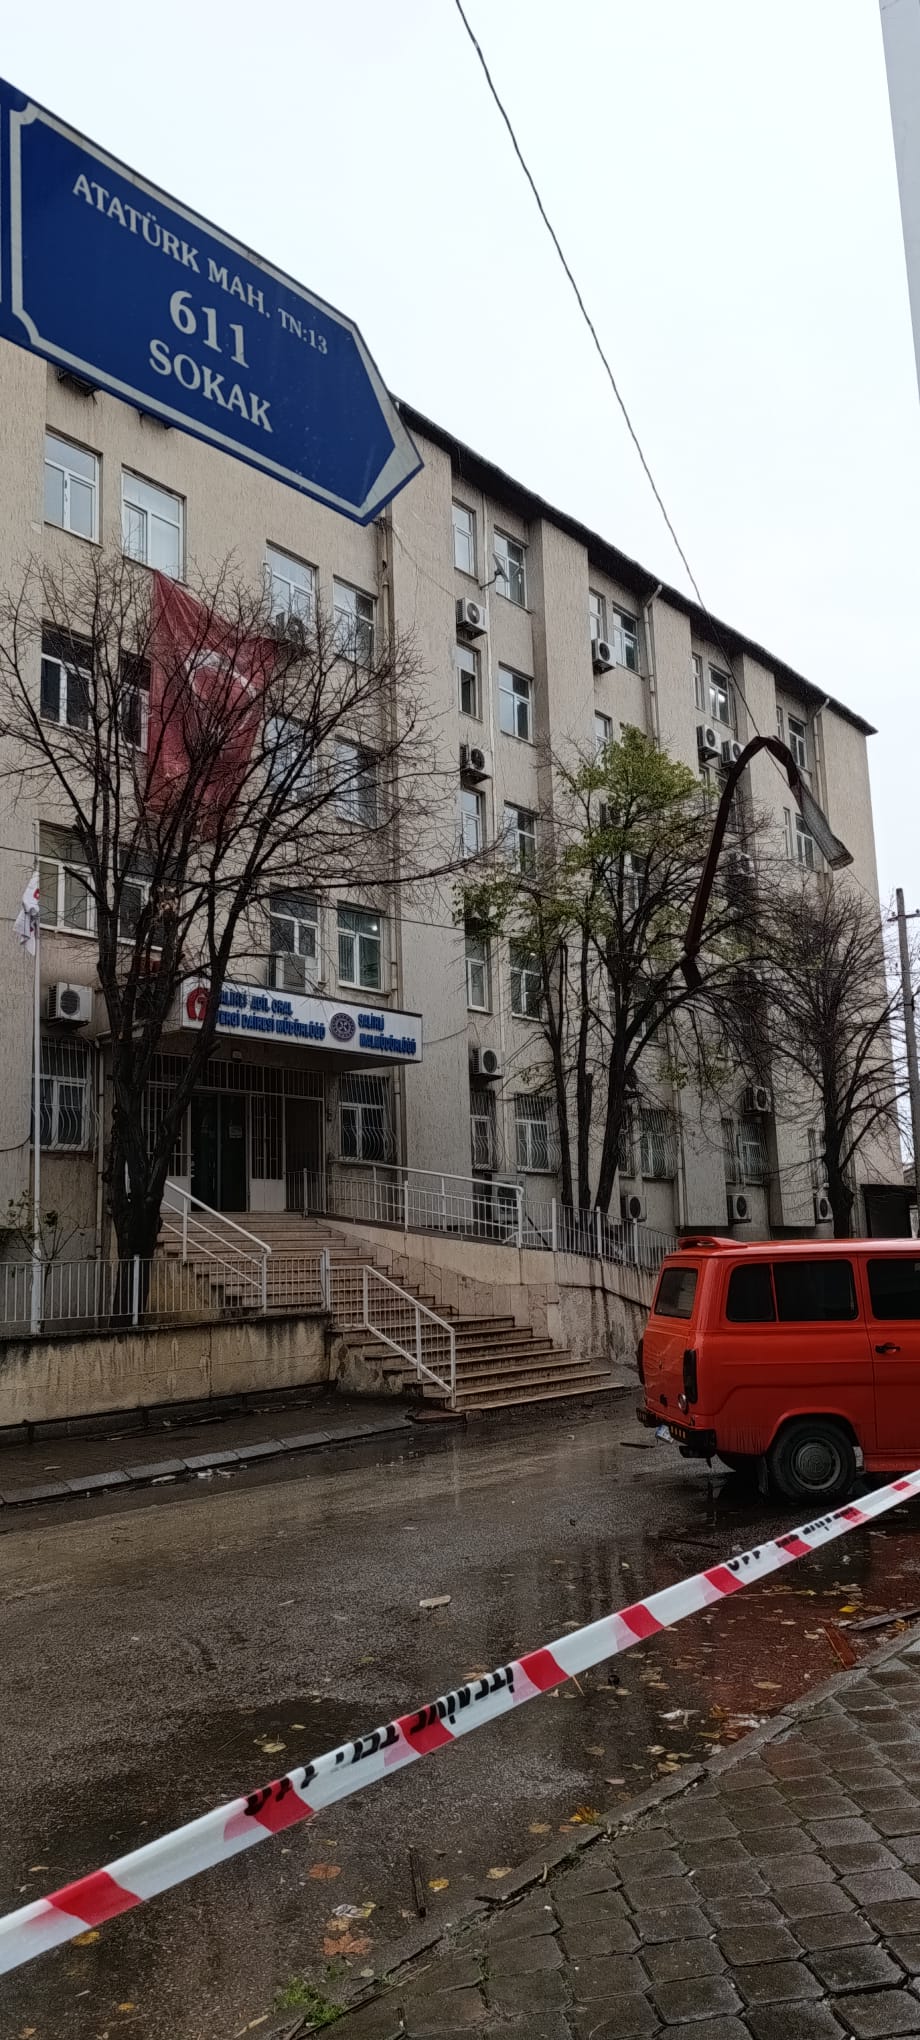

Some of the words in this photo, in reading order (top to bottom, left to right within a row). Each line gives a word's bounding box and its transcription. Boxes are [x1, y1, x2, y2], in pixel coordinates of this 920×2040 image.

[72, 174, 200, 273] ATATÜRK
[208, 258, 271, 318] MAH.
[277, 308, 328, 354] TN:13
[169, 290, 249, 368] 611
[149, 339, 273, 433] SOKAK
[219, 989, 248, 1009] ALİHLİ
[241, 1012, 274, 1032] DAİRESİ
[276, 1017, 325, 1040] MÜDÜRLÜĞÜ
